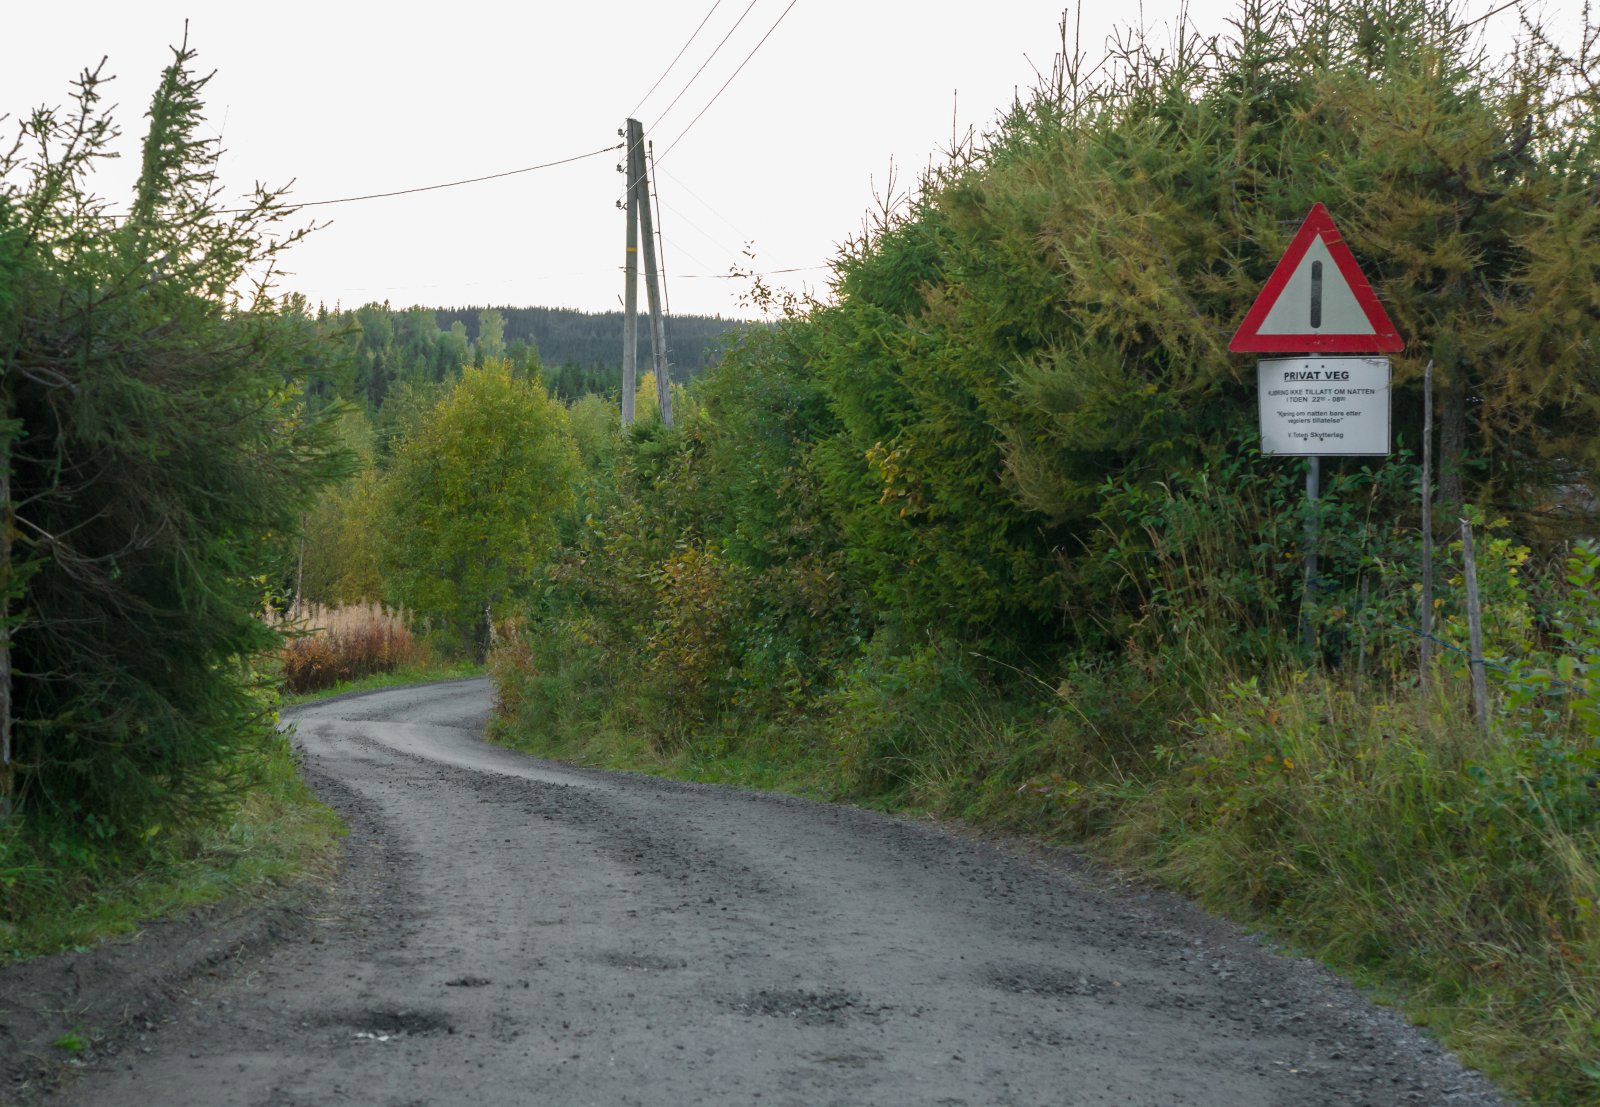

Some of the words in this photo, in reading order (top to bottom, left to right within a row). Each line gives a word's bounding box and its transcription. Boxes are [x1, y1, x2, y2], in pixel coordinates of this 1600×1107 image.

[1284, 371, 1321, 380] PRIVAT
[1324, 371, 1350, 380] VEG
[1310, 431, 1344, 440] Skytterlag
